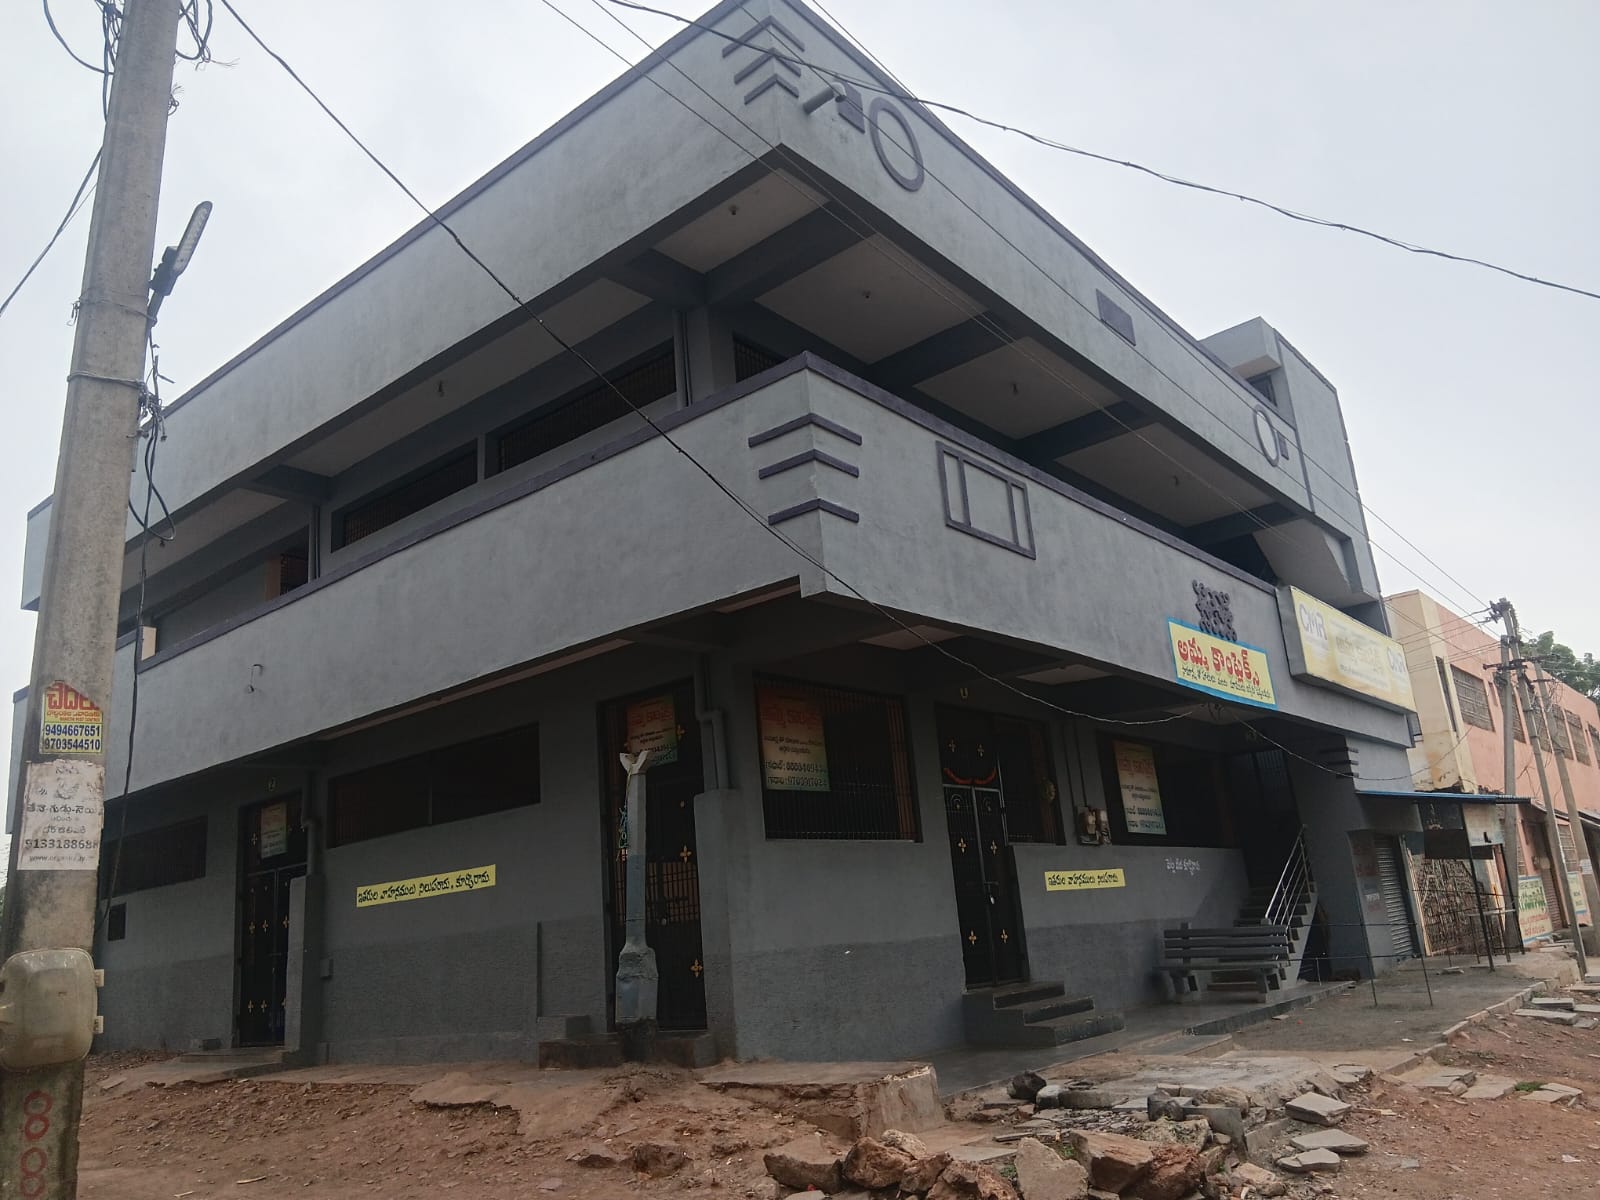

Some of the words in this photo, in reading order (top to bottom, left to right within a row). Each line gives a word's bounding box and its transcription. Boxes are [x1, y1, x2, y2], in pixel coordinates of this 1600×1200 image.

[1177, 637, 1210, 671] అమ్మ
[45, 724, 100, 737] 9494667651
[44, 738, 100, 751] 9703544510
